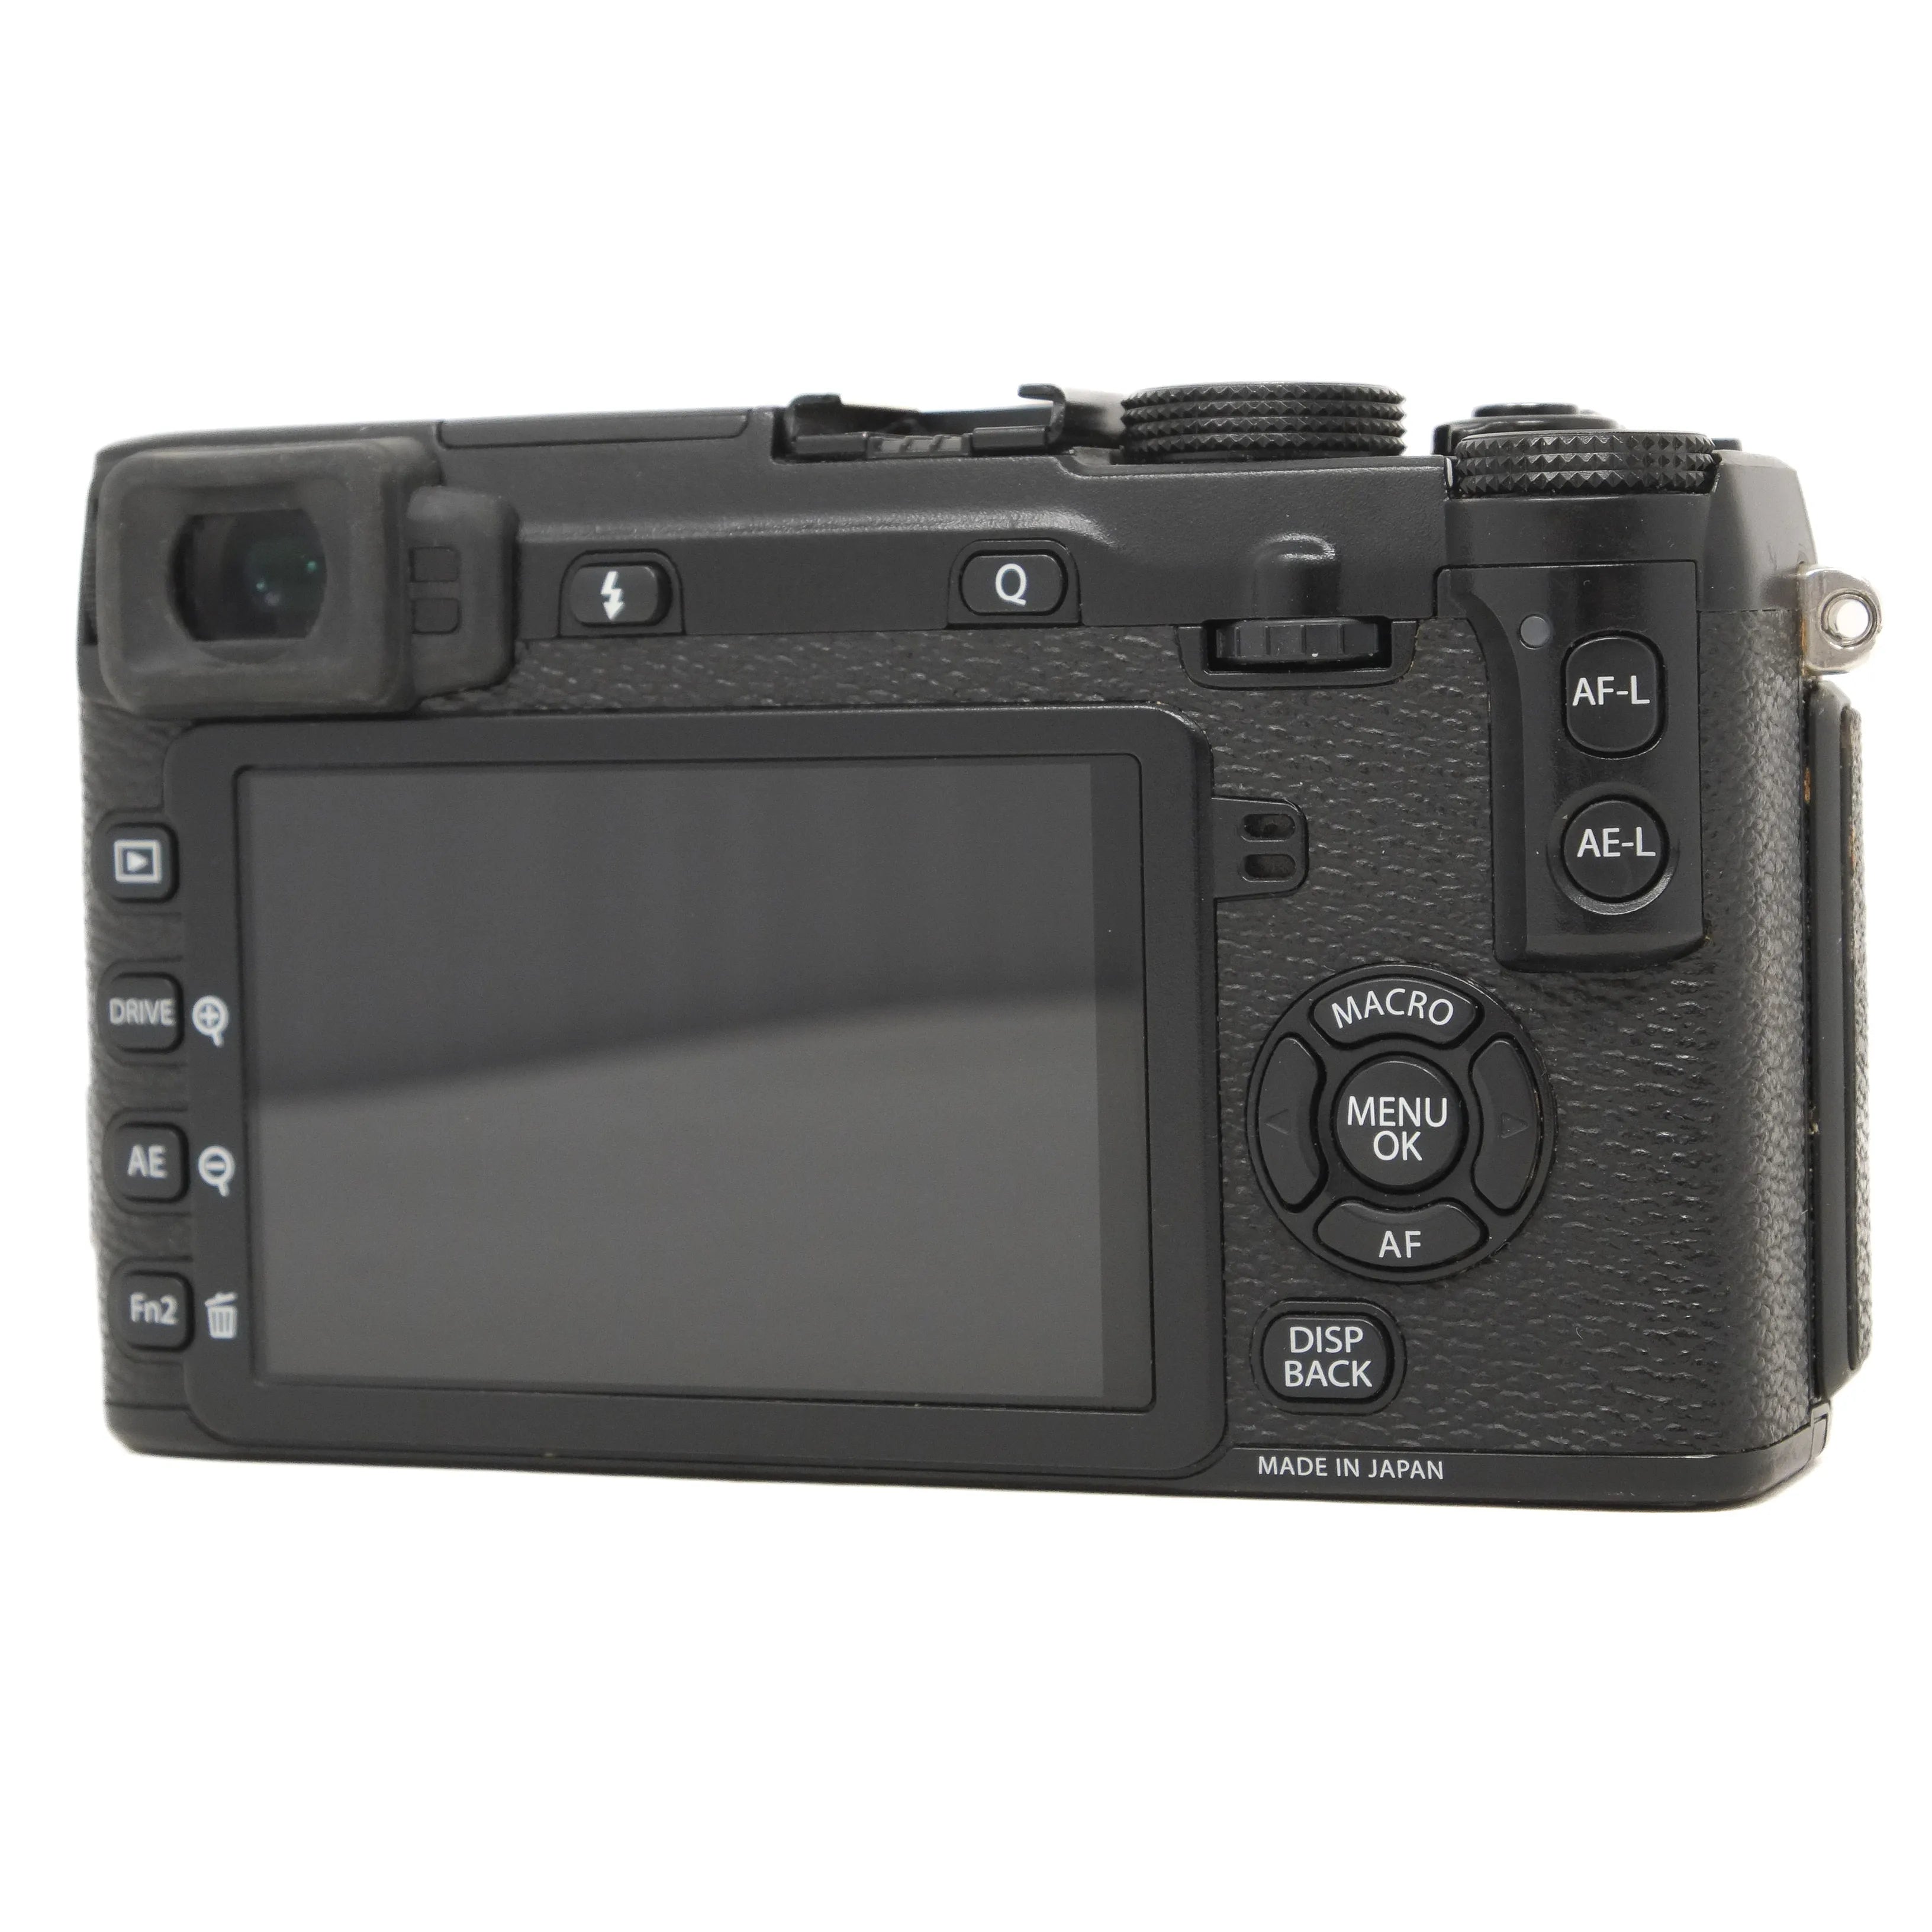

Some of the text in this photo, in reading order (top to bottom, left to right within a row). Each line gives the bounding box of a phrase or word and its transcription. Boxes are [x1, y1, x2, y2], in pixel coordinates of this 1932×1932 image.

[996, 564, 1026, 606] Q
[1572, 675, 1650, 706] AF-L
[1577, 827, 1656, 858] AE-L
[109, 998, 173, 1026] DRIVE
[1331, 987, 1454, 1029] MACRO
[1347, 1096, 1448, 1128] MENU
[1373, 1130, 1423, 1161] OK
[127, 1145, 166, 1178] AE
[1379, 1231, 1421, 1258] AF
[130, 1293, 177, 1325] Fn2
[1290, 1326, 1364, 1353] DISP
[1284, 1360, 1373, 1387] BACK
[1258, 1456, 1443, 1480] MADE IN JAPAN
